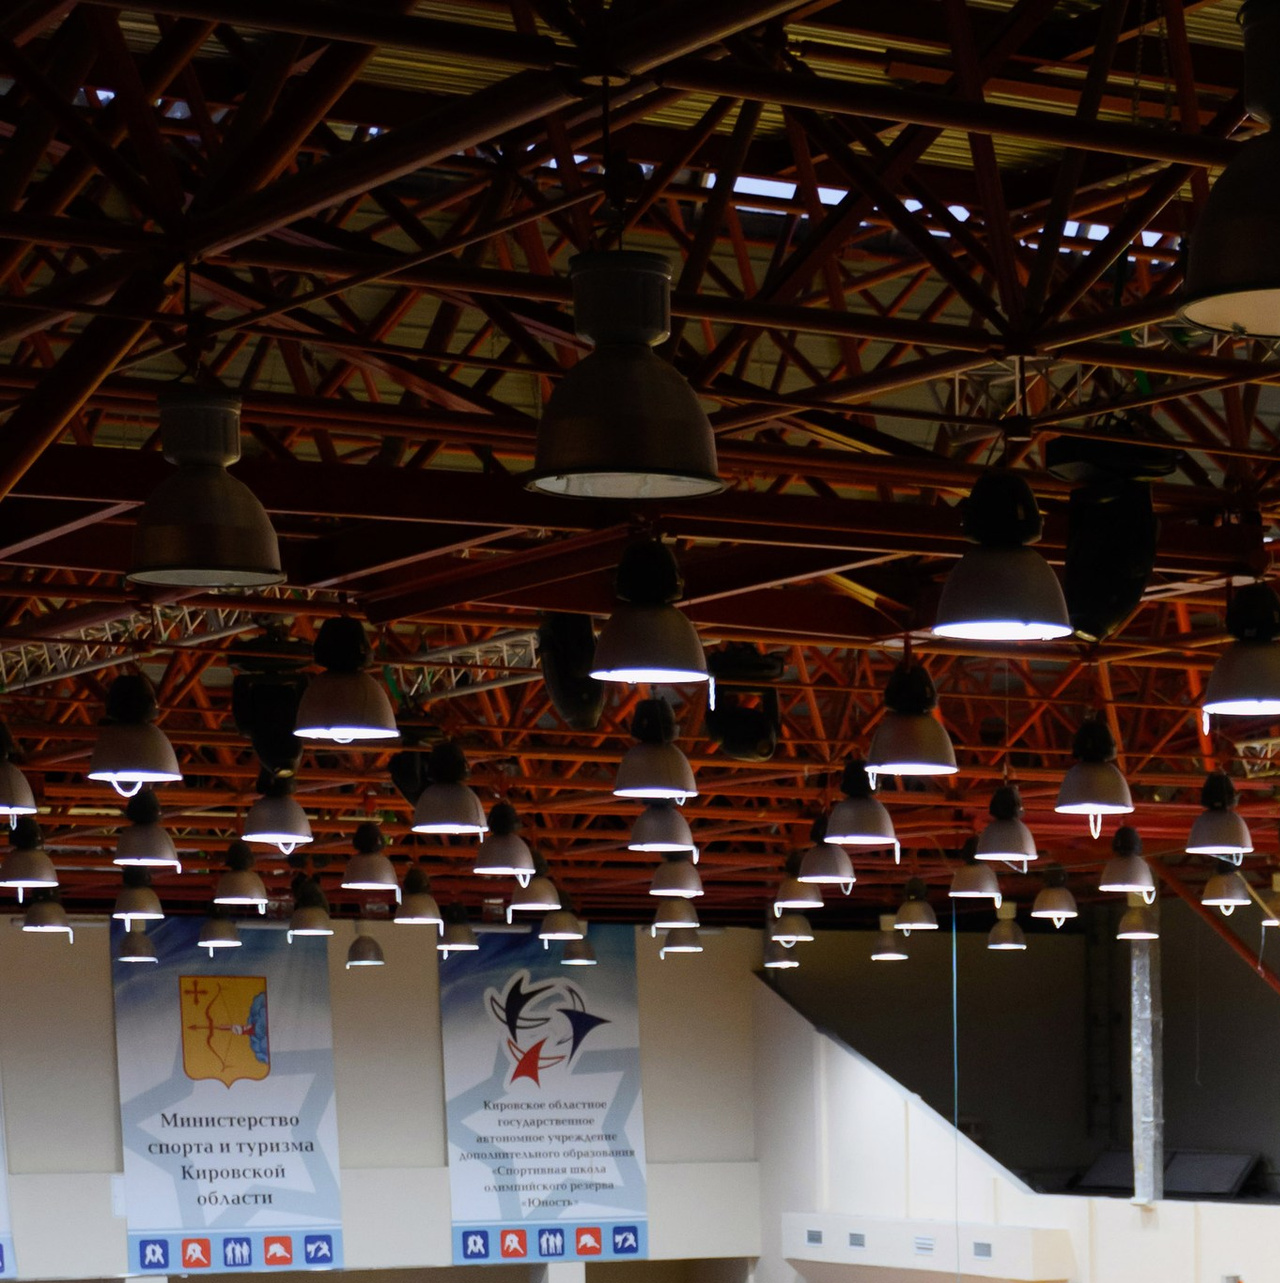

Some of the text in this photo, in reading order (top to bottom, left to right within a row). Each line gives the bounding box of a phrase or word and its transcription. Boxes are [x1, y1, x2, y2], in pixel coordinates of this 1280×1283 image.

[483, 1099, 607, 1112] Кировское областное
[160, 1113, 300, 1130] Министерство
[497, 1117, 595, 1129] государственное
[476, 1133, 618, 1145] автономное учреждение
[148, 1139, 315, 1156] спорта и туризма
[562, 1148, 636, 1161] образования
[181, 1164, 286, 1181] Кировской
[570, 1165, 607, 1175] школа
[570, 1180, 614, 1193] резерва
[197, 1190, 274, 1206] области
